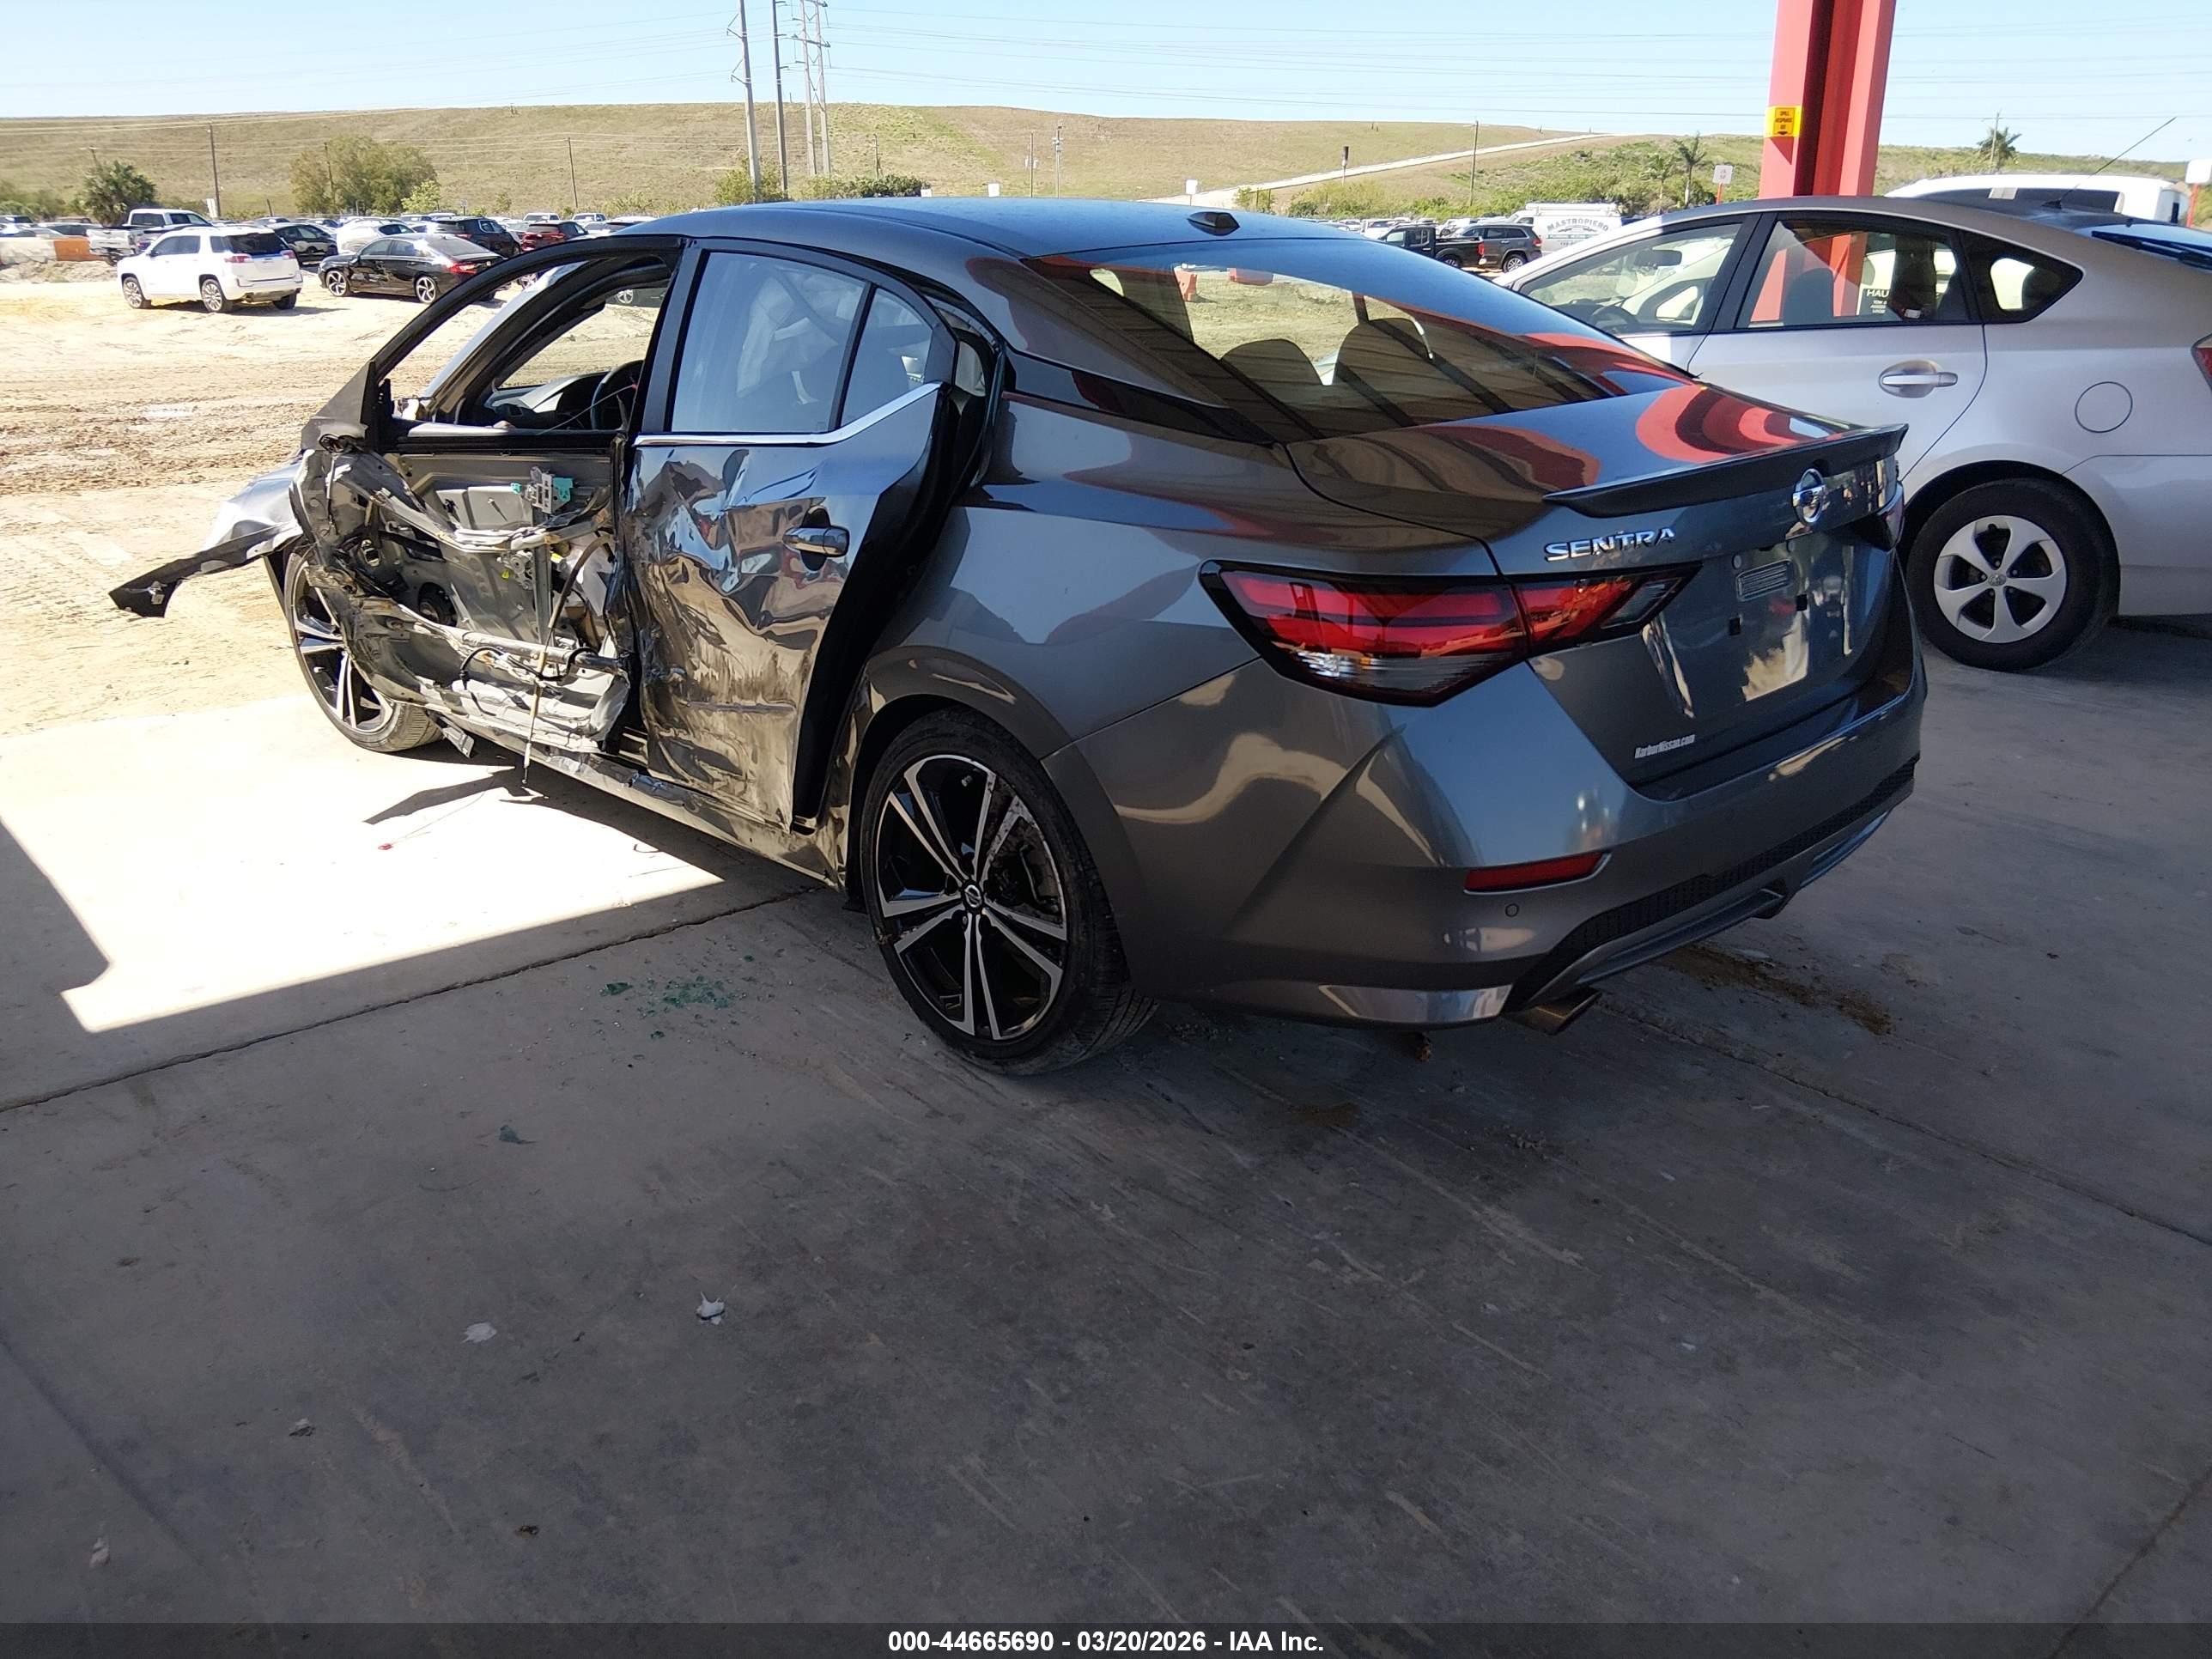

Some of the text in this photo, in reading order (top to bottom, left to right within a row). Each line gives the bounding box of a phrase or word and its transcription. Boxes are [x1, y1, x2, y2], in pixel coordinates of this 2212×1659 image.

[1547, 218, 1610, 232] MASTROPIERO
[1866, 289, 1890, 297] HAU
[1544, 527, 1675, 562] SENTRA
